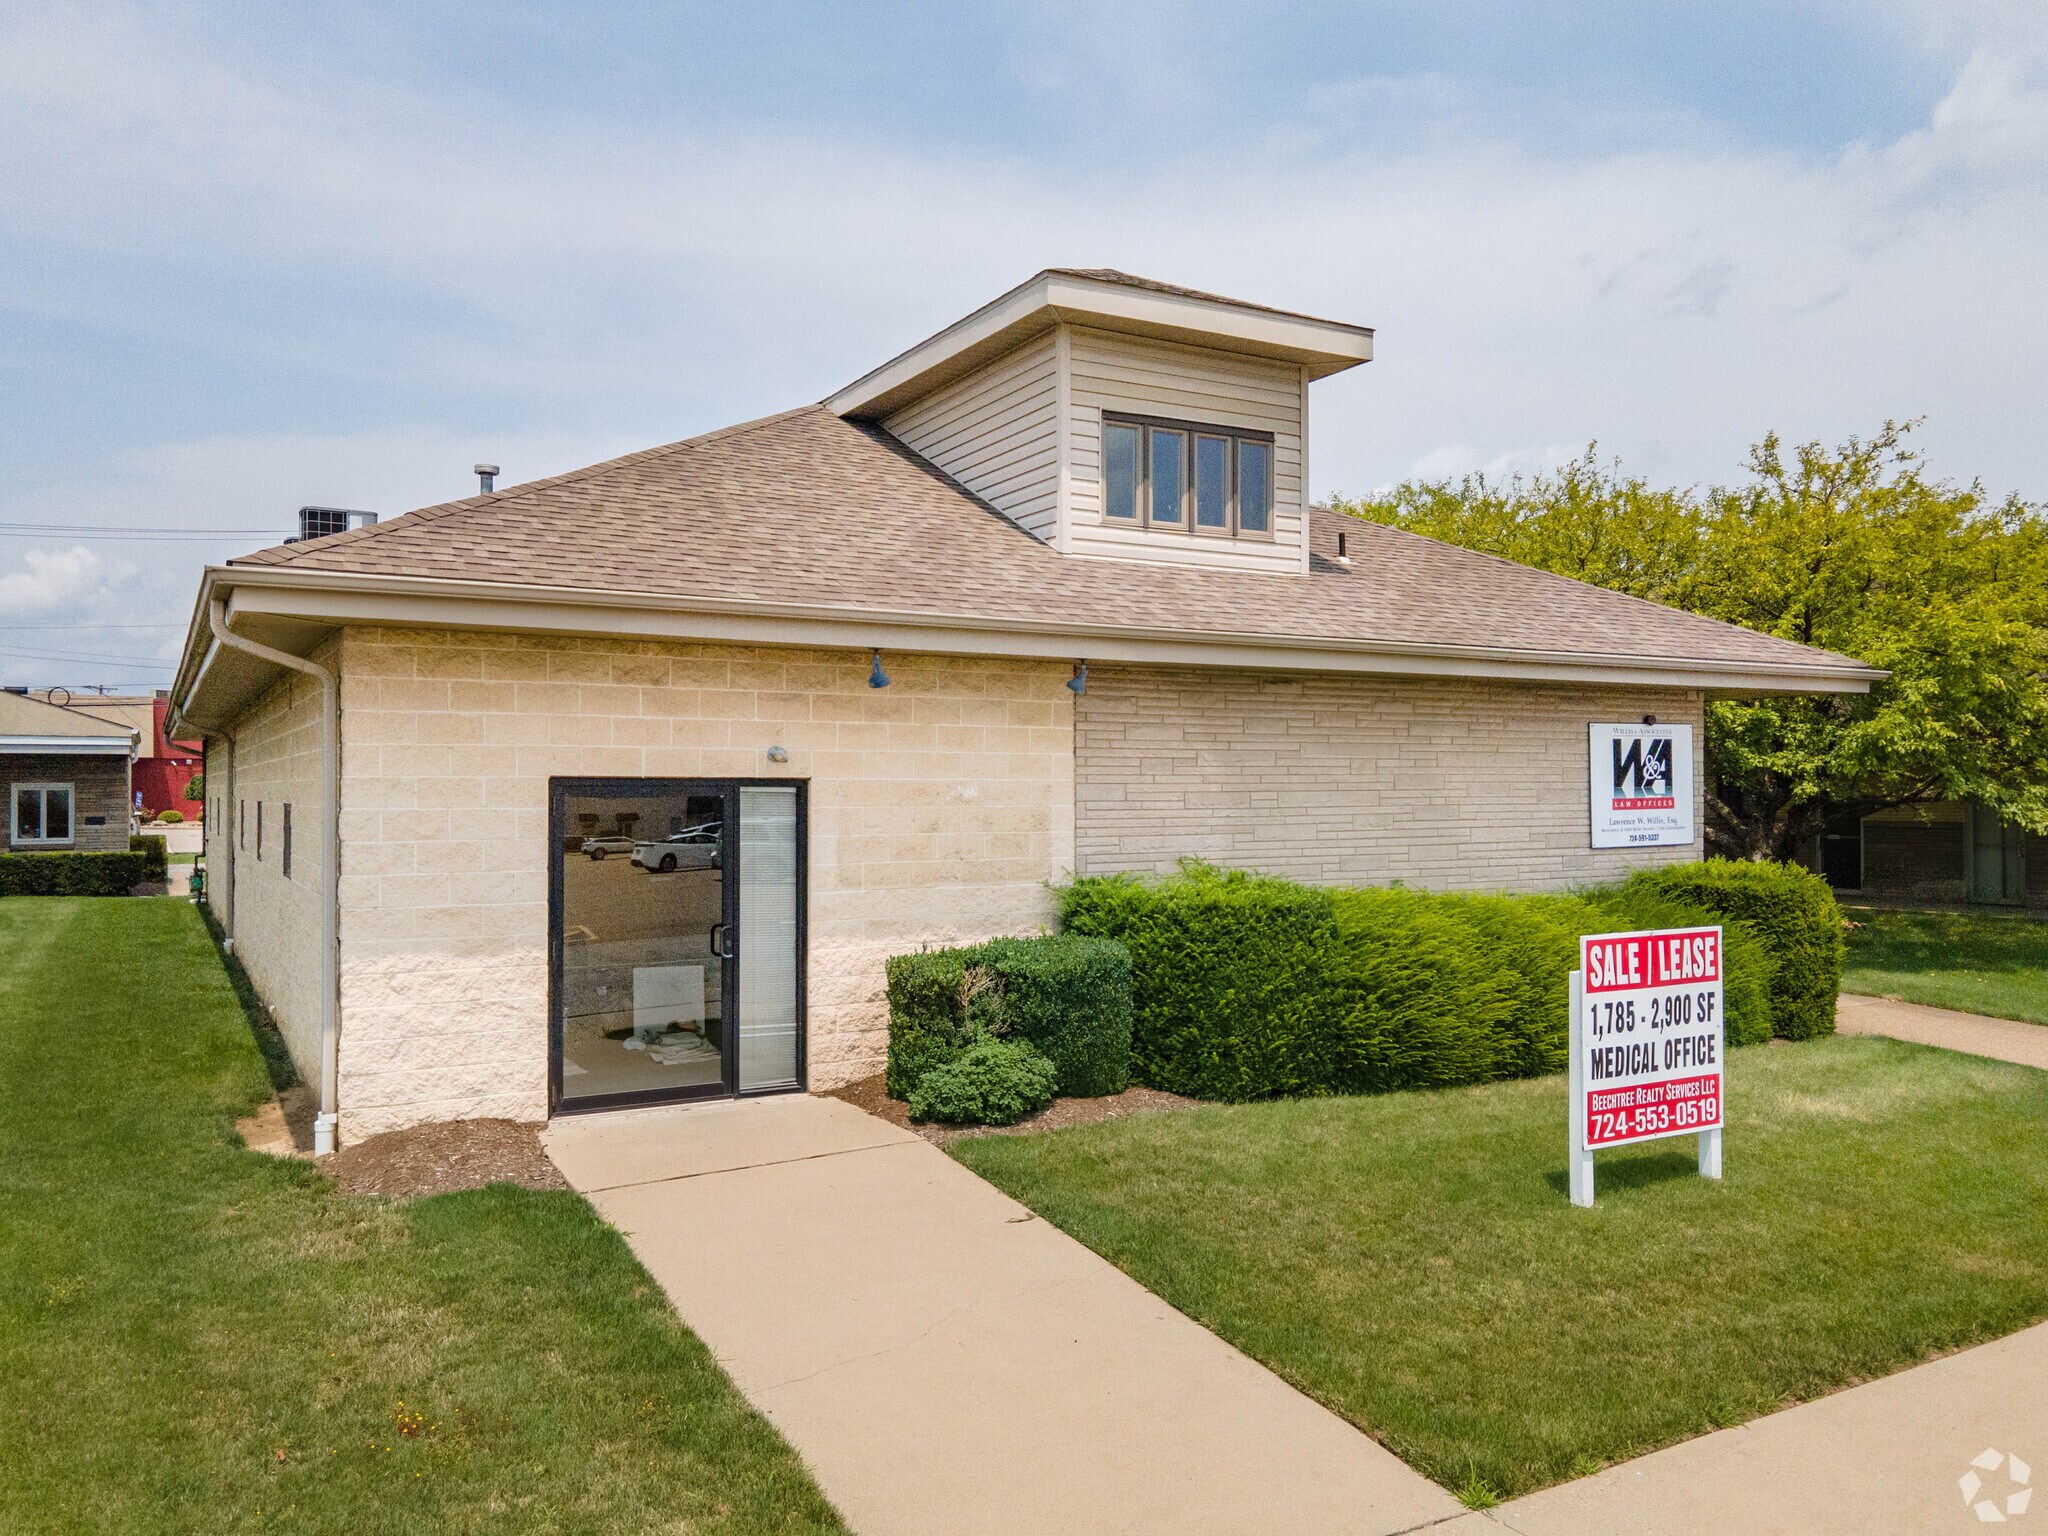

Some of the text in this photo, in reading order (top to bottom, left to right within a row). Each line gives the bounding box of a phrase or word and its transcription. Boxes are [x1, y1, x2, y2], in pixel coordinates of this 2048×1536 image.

[1638, 727, 1673, 735] ASSOCIATES
[1609, 818, 1636, 826] Lawrence
[1637, 817, 1646, 825] W.
[1589, 943, 1642, 988] SALE
[1657, 936, 1716, 982] LEASE
[1591, 1000, 1636, 1042] 1,785
[1651, 993, 1692, 1034] 2,900
[1697, 991, 1715, 1023] SF
[1591, 1034, 1716, 1081] MEDICAL OFFICE
[1591, 1097, 1718, 1140] 724-553-0519
[1592, 1091, 1635, 1112] BEECHTREE
[1636, 1087, 1665, 1105] REALTY
[1666, 1083, 1700, 1101] SERVICES
